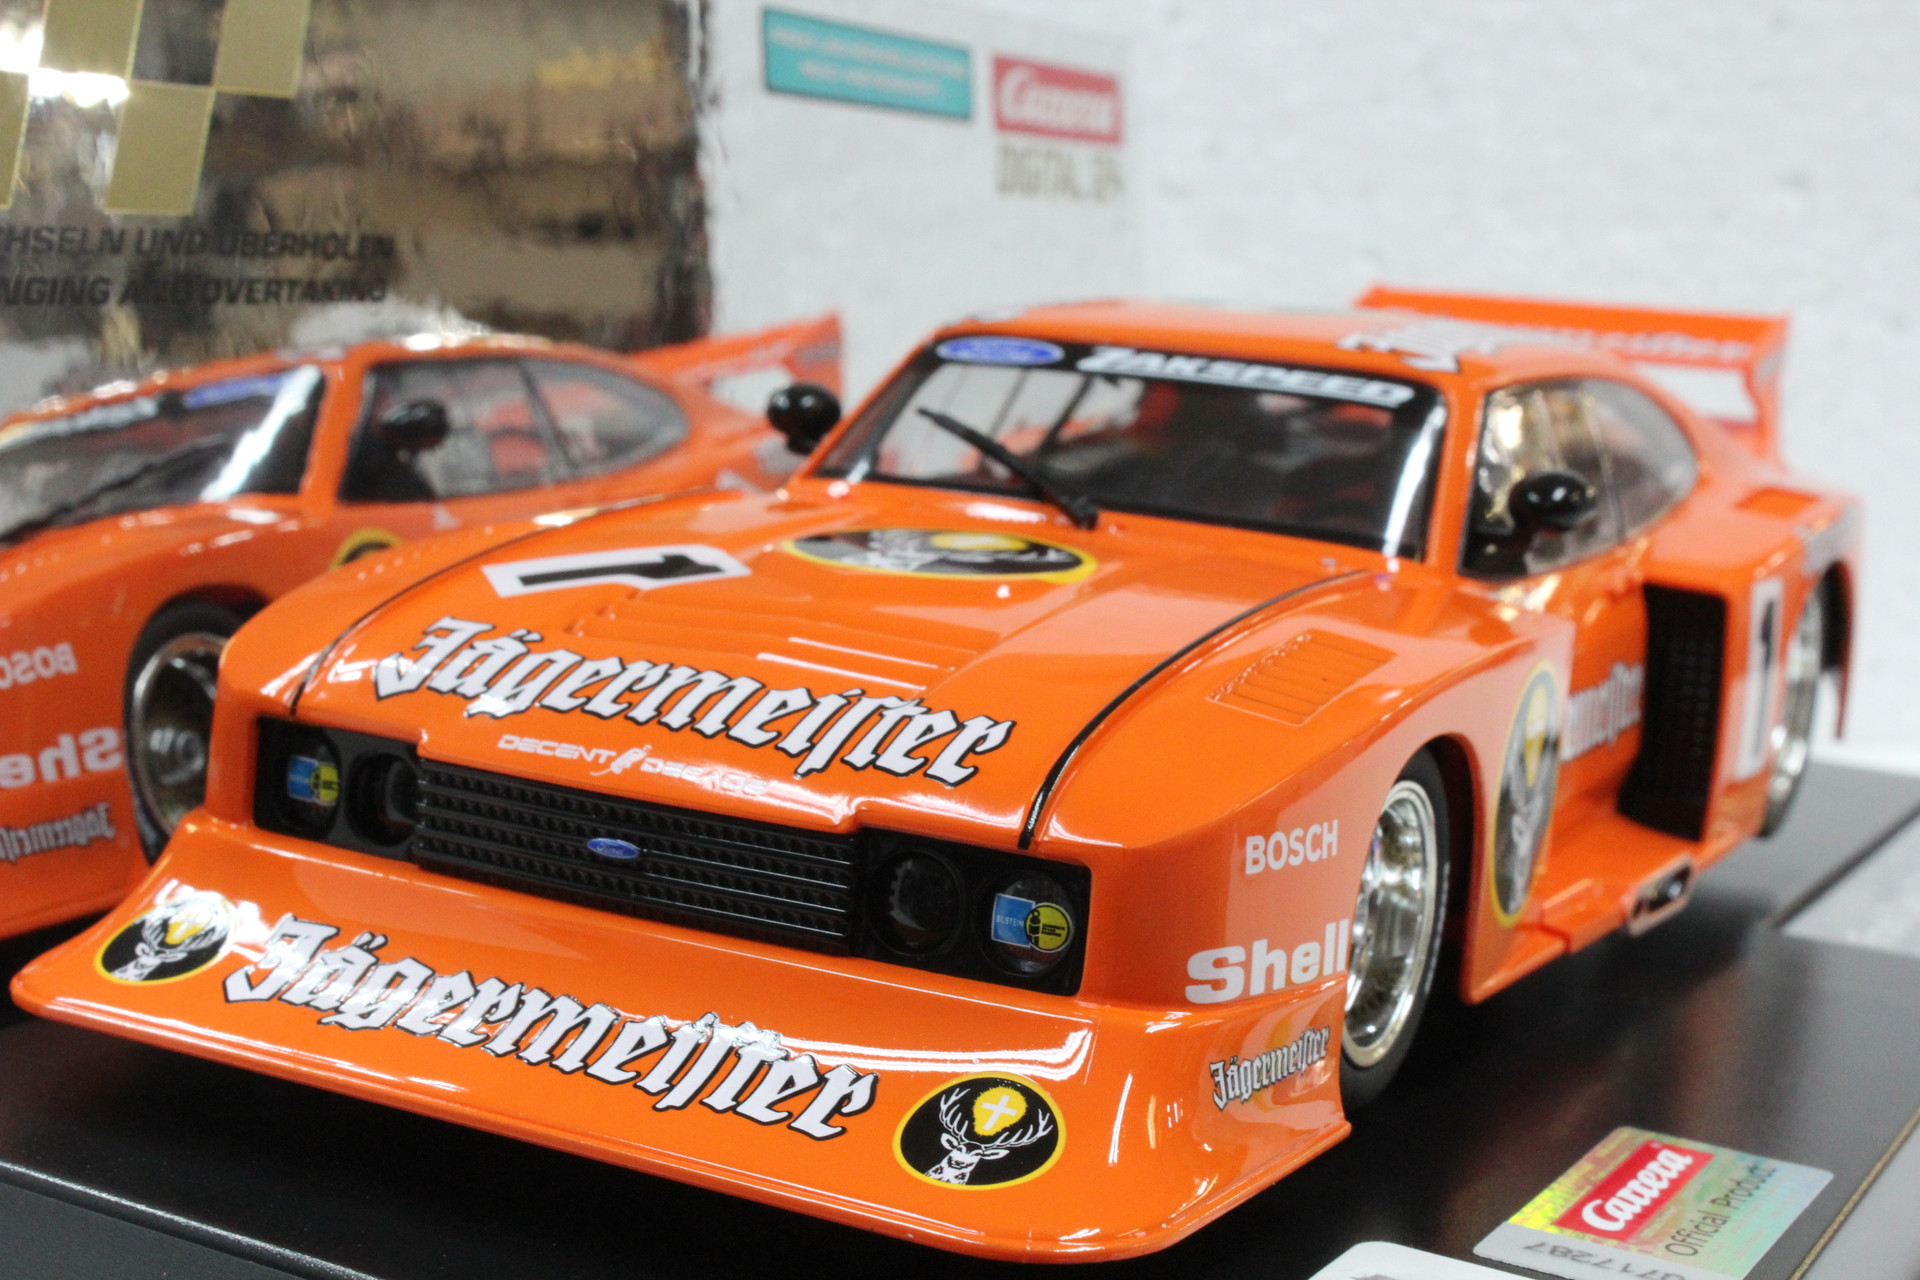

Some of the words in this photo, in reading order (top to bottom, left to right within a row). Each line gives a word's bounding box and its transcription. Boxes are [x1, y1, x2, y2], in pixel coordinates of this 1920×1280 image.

[134, 226, 206, 256] UND
[497, 734, 617, 764] DECENT
[1245, 819, 1339, 875] BOSCH
[1185, 918, 1349, 1005] Shell
[1581, 1148, 1694, 1231] Carrera
[1664, 1205, 1732, 1258] Official
